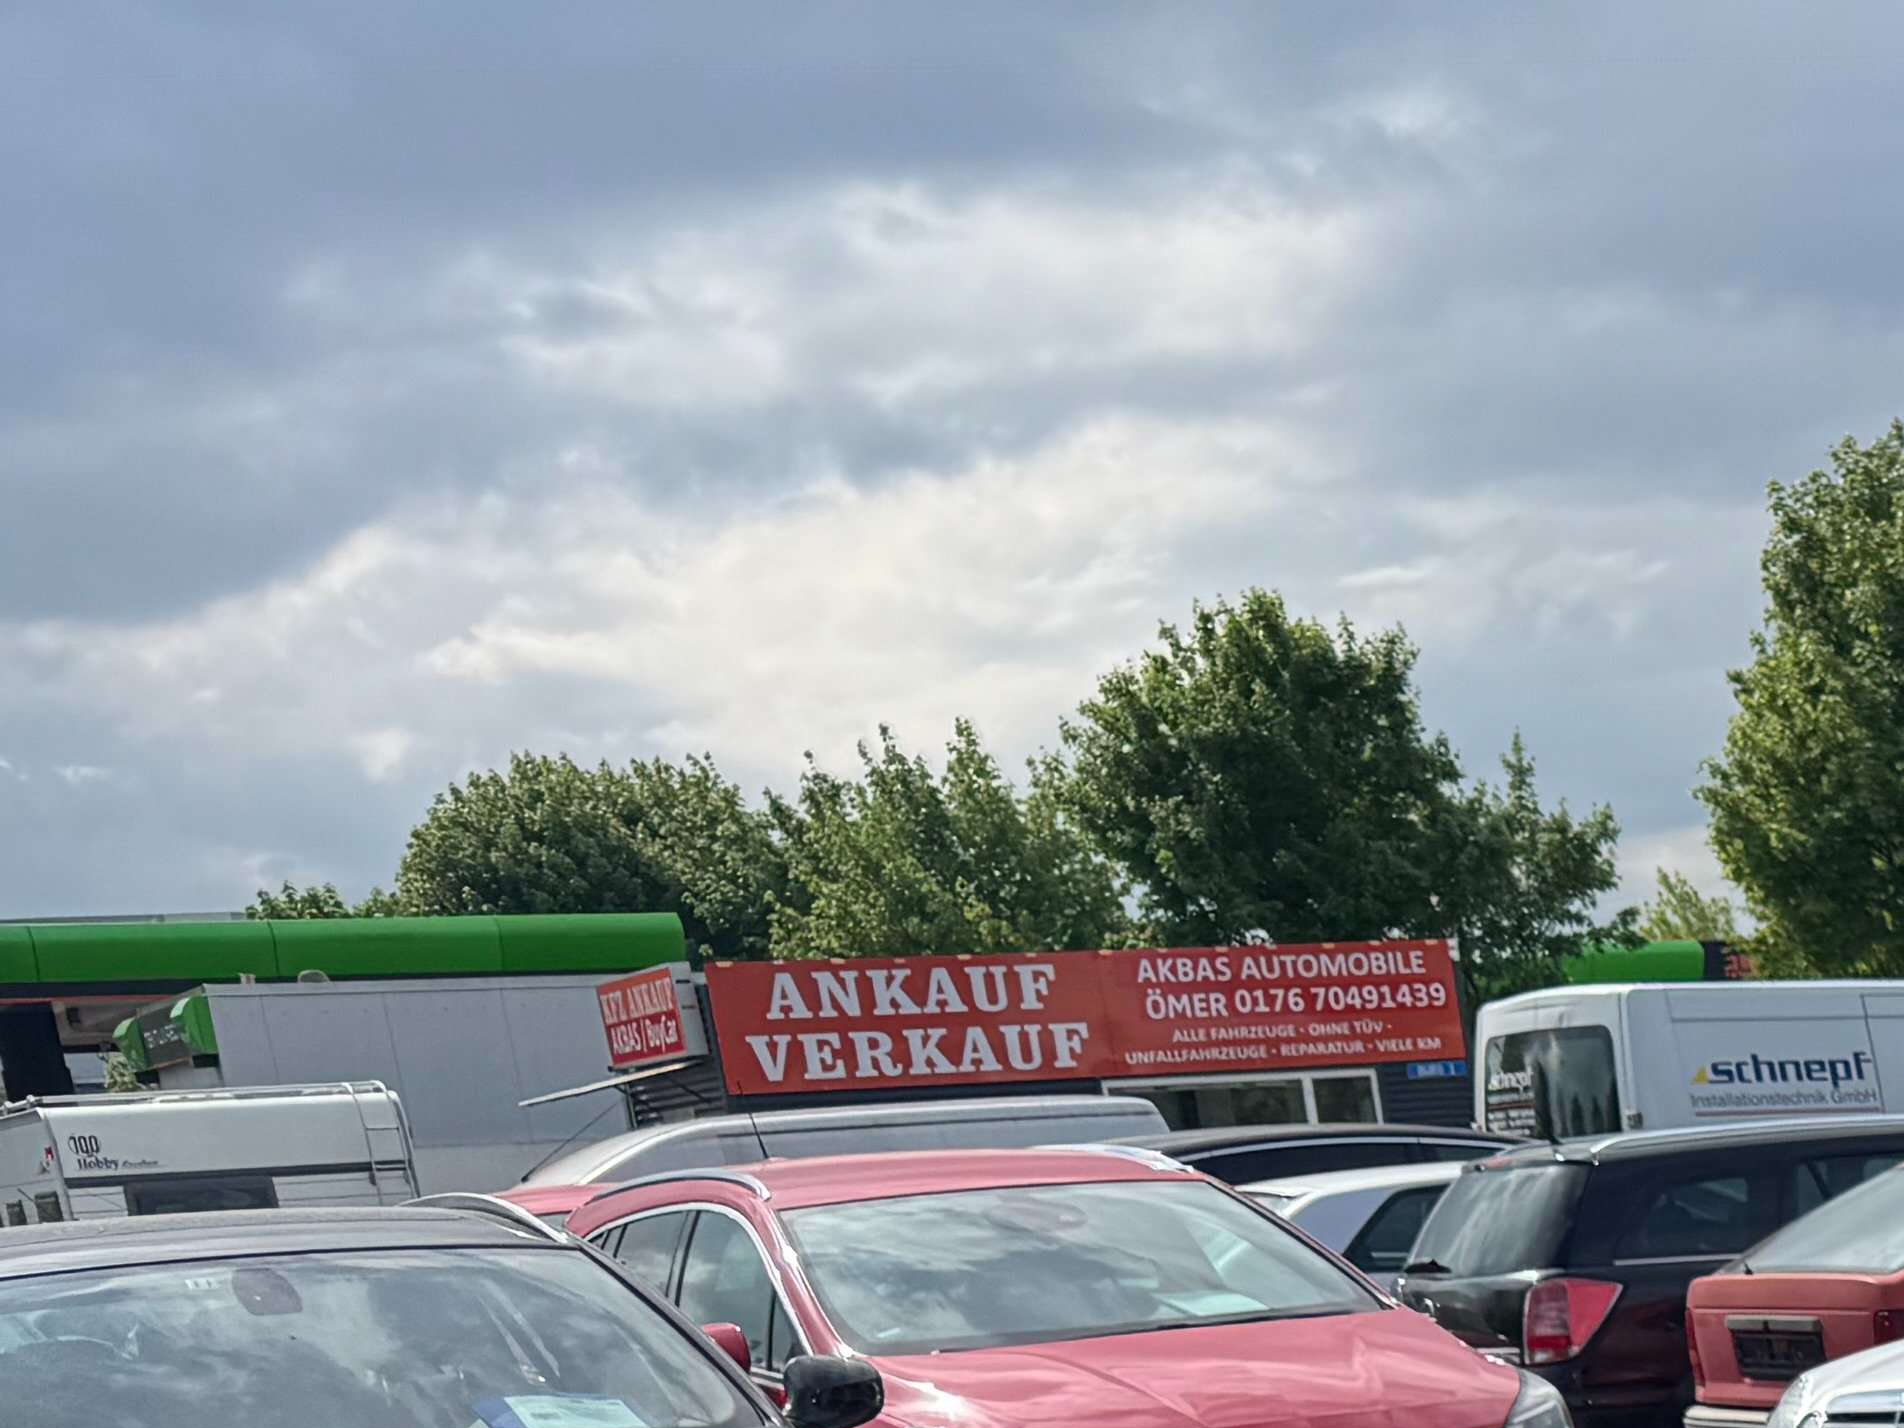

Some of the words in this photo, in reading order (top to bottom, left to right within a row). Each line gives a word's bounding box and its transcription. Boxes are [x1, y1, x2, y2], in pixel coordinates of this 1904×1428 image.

[1137, 957, 1231, 984] AKBAS
[1240, 951, 1426, 980] AUTOMOBILE
[766, 964, 1056, 1020] ANKAUF
[1145, 988, 1228, 1020] ÖMER
[1234, 988, 1305, 1014] 0176
[1310, 982, 1447, 1012] 70491439
[745, 1022, 1089, 1081] VERKAUF
[1709, 1051, 1873, 1088] schnepf
[1690, 1089, 1827, 1108] Installationstechnik
[1831, 1088, 1877, 1104] GmbH
